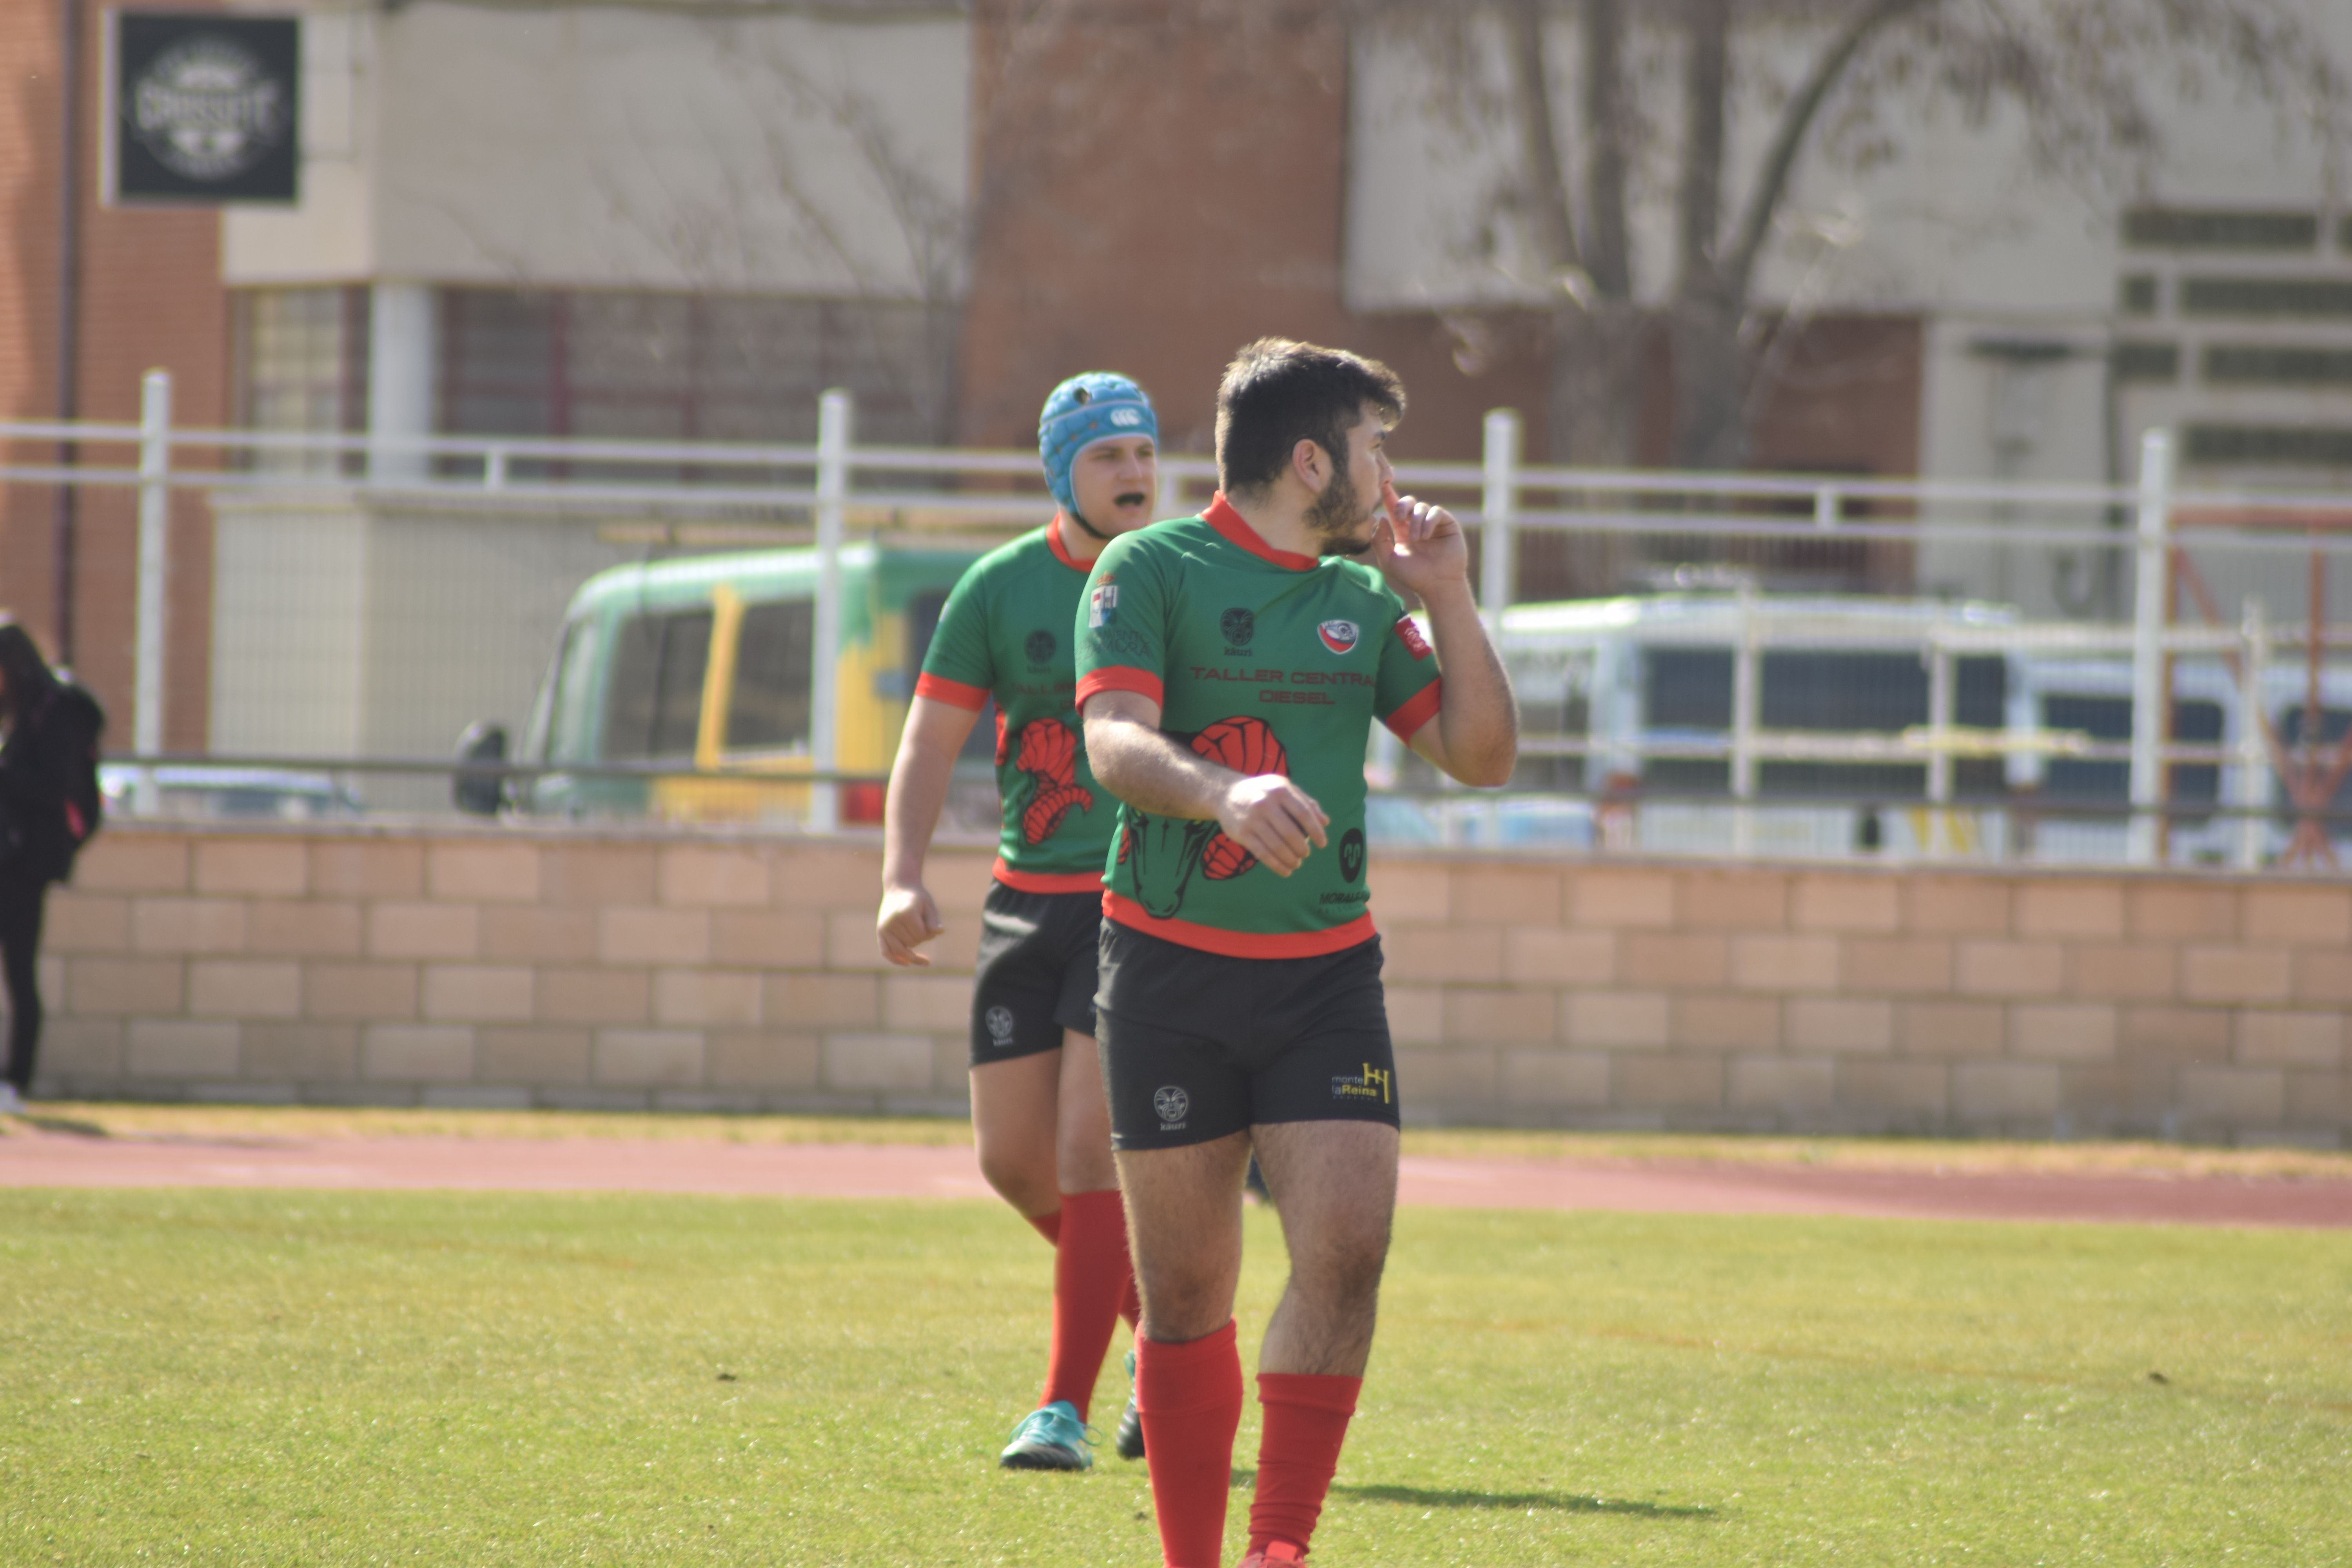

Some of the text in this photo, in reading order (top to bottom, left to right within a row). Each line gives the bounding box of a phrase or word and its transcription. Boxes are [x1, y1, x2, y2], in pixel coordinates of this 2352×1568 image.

[1189, 666, 1376, 688] TALLER CENTRA
[1259, 690, 1336, 705] DIESEL
[1332, 1076, 1363, 1085] monte
